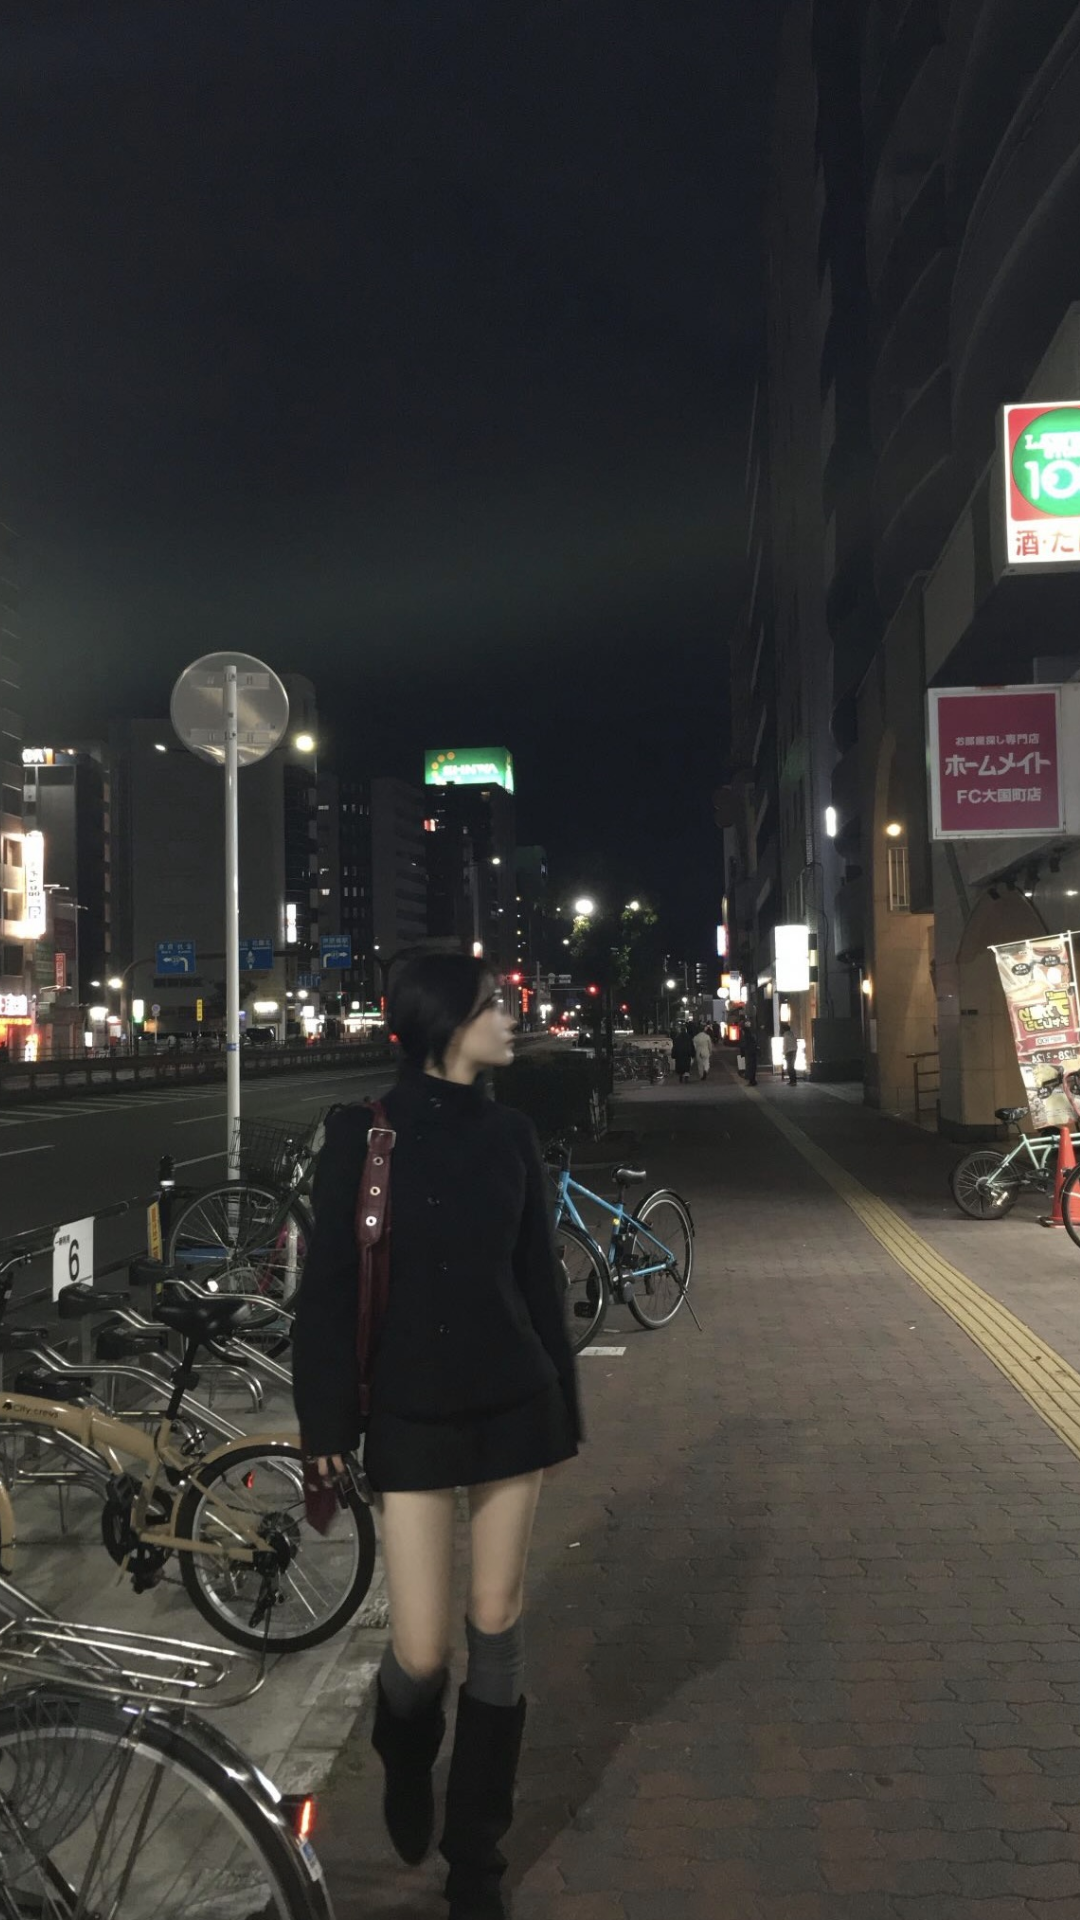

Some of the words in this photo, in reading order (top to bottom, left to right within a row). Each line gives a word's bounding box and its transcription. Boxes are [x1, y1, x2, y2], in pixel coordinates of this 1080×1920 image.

[1024, 460, 1080, 501] 10
[955, 733, 1040, 747] お部屋探し専門店
[442, 763, 499, 776] SHINWA
[944, 752, 1052, 777] ホームメイト
[956, 787, 1042, 804] FC大国町店
[69, 1239, 80, 1282] 6
